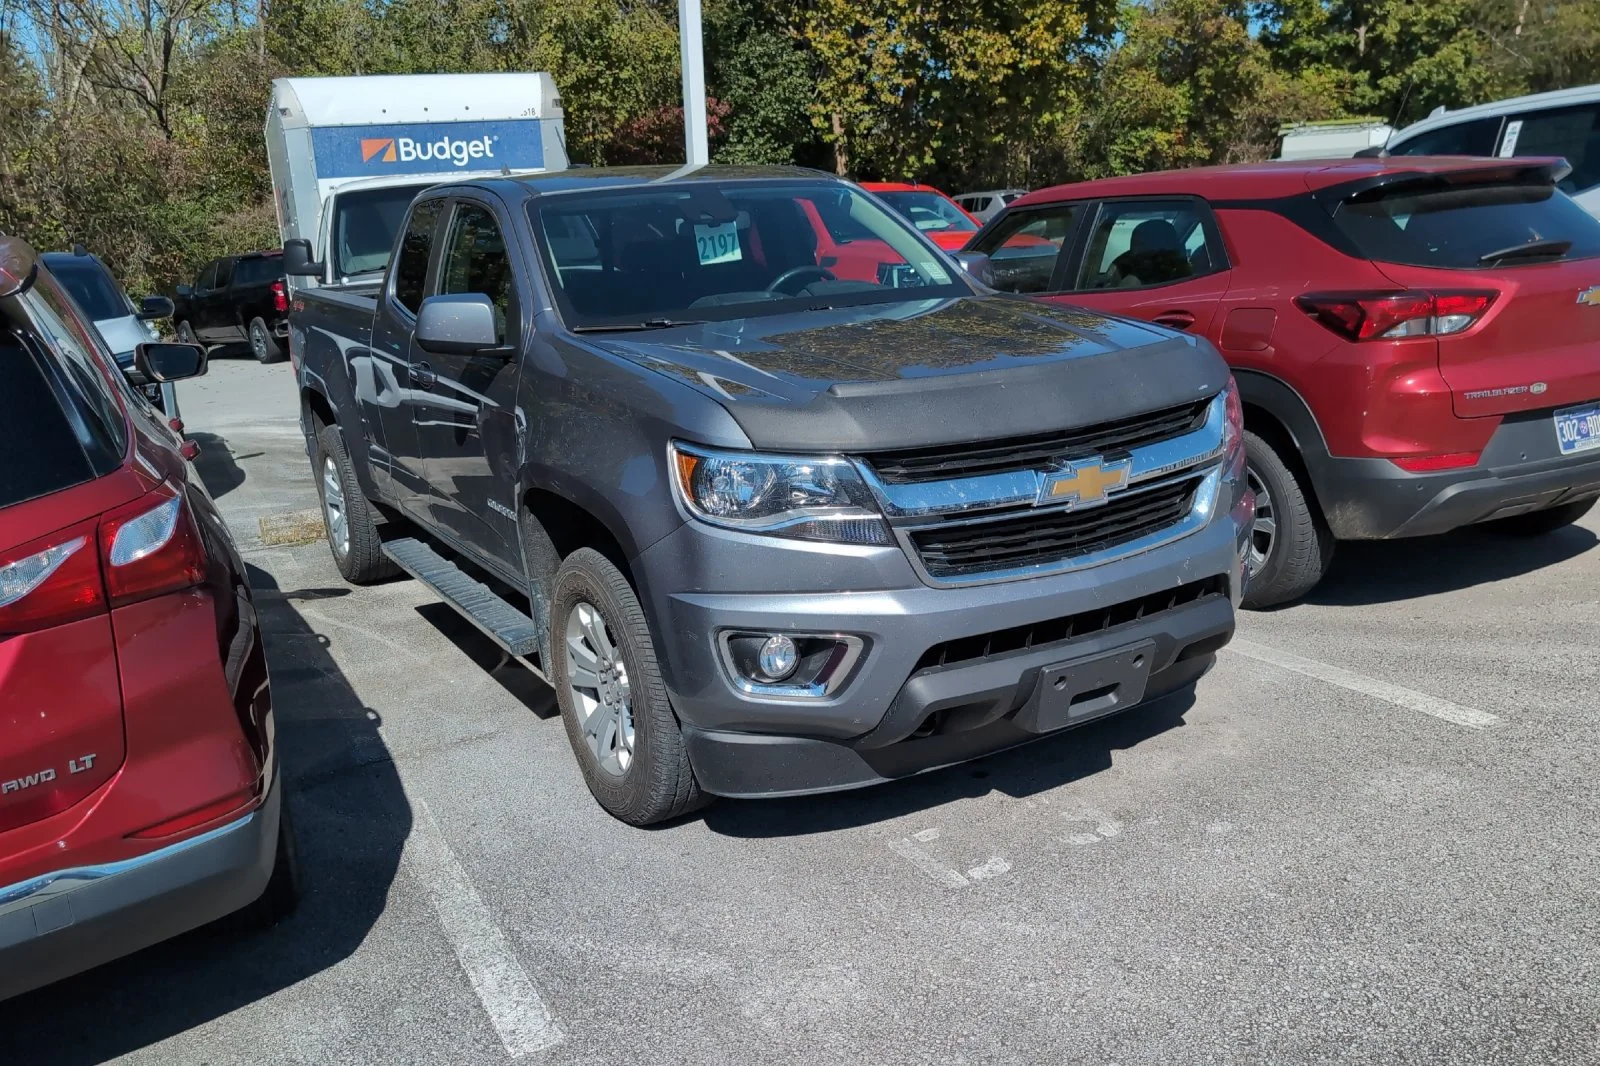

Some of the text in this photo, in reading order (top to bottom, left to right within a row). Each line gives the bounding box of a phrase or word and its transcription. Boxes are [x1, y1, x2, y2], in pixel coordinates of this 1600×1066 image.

[399, 135, 494, 167] Budget
[698, 232, 736, 260] 2197
[1558, 418, 1581, 442] 302
[1, 753, 97, 794] AWD LT
